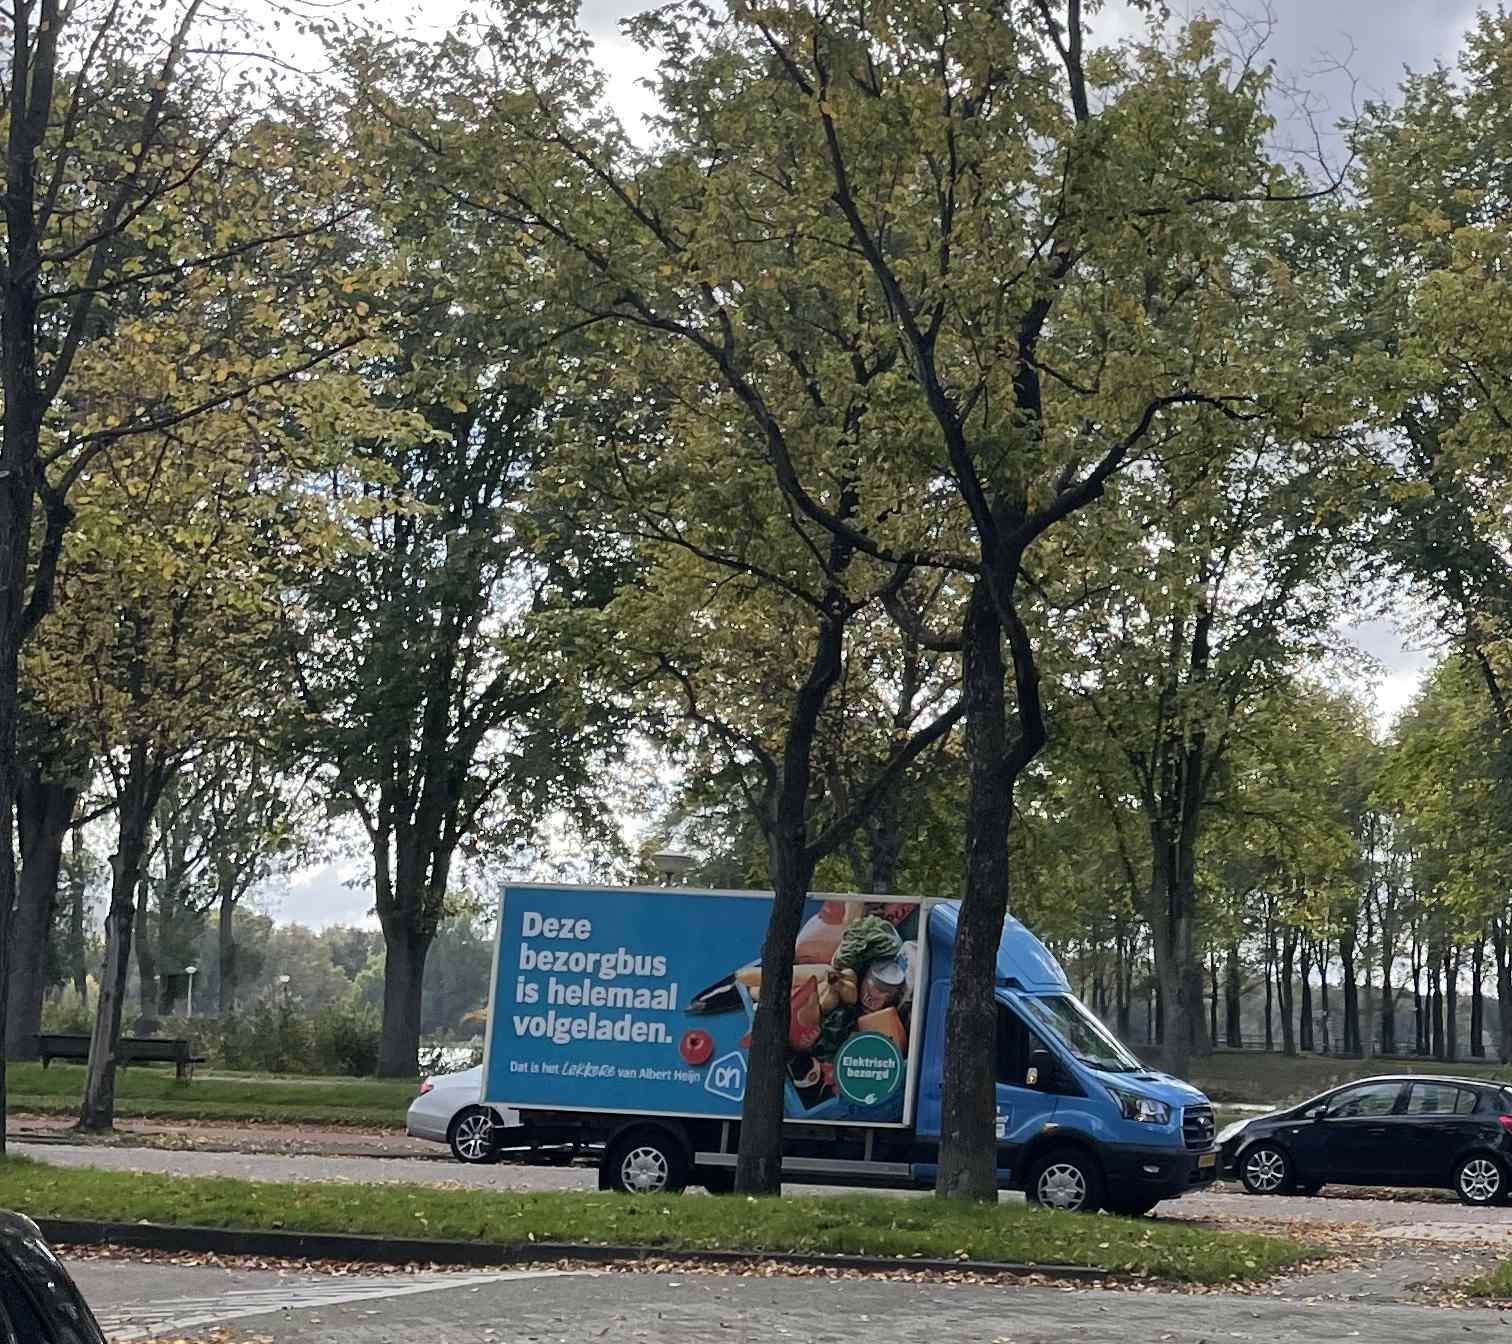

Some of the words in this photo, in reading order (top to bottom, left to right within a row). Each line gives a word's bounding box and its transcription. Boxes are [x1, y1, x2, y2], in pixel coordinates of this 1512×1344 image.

[521, 911, 592, 940] Deze
[519, 942, 668, 980] bezorgbus
[515, 975, 539, 1004] is
[547, 976, 679, 1011] helemaal
[512, 1010, 673, 1045] volgeladen.
[510, 1060, 528, 1073] Dat
[530, 1061, 540, 1073] is
[542, 1061, 560, 1074] het
[617, 1067, 637, 1079] van
[639, 1066, 672, 1081] Albert
[674, 1068, 701, 1084] Heijn
[842, 1056, 896, 1069] Elektrisch
[847, 1067, 890, 1080] bezorgd
